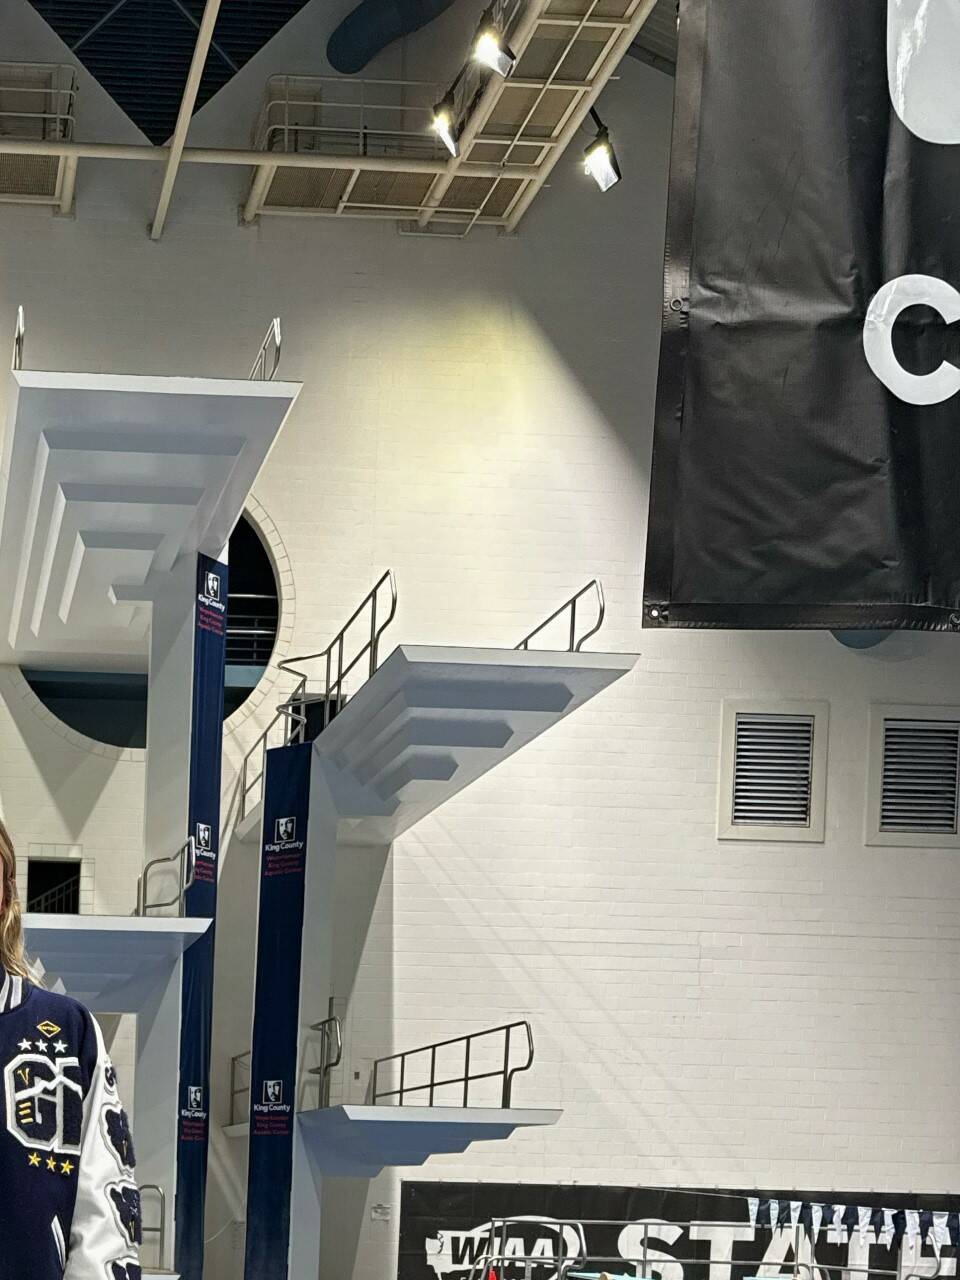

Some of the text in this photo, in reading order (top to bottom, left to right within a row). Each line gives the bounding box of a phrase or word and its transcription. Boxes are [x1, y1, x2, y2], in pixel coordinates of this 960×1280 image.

[265, 841, 303, 852] King County
[254, 1104, 290, 1112] King County
[450, 1235, 554, 1268] WIAA
